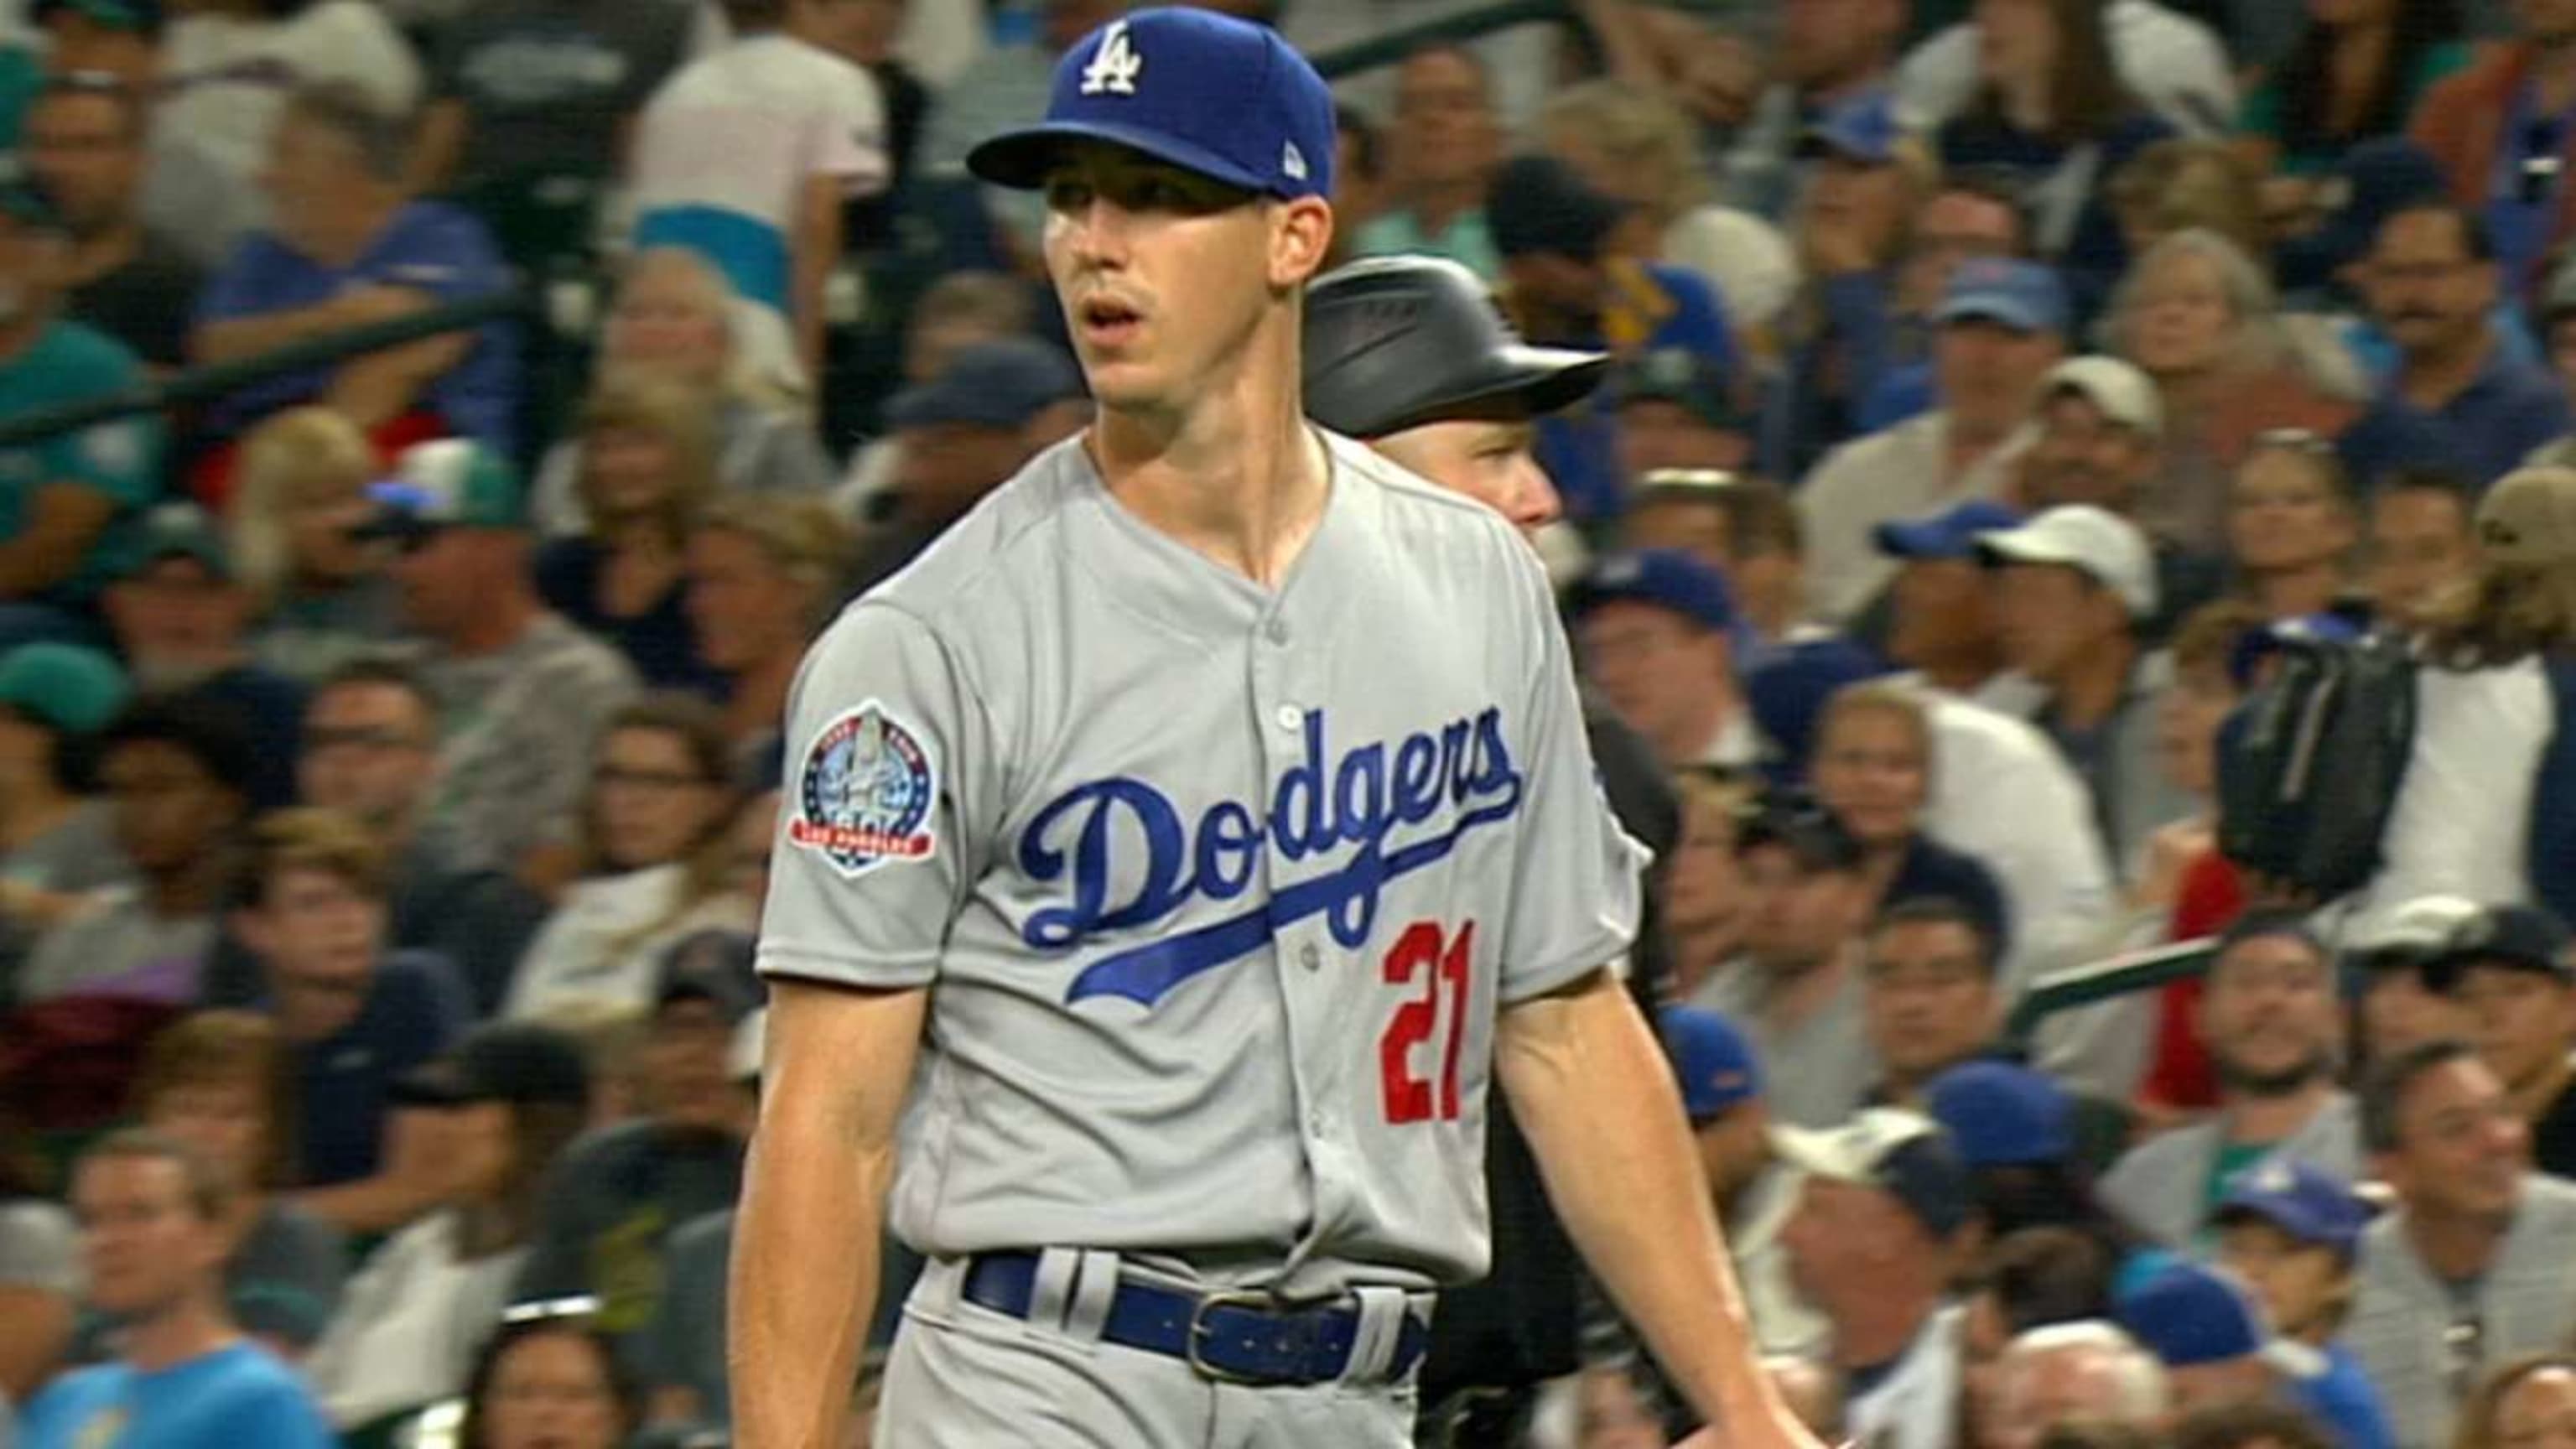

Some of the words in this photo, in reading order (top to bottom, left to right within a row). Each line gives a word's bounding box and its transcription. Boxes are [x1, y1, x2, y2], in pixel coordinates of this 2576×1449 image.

[1081, 19, 1142, 95] LA
[1019, 706, 1521, 951] Dodgers
[1379, 919, 1475, 1125] 21
